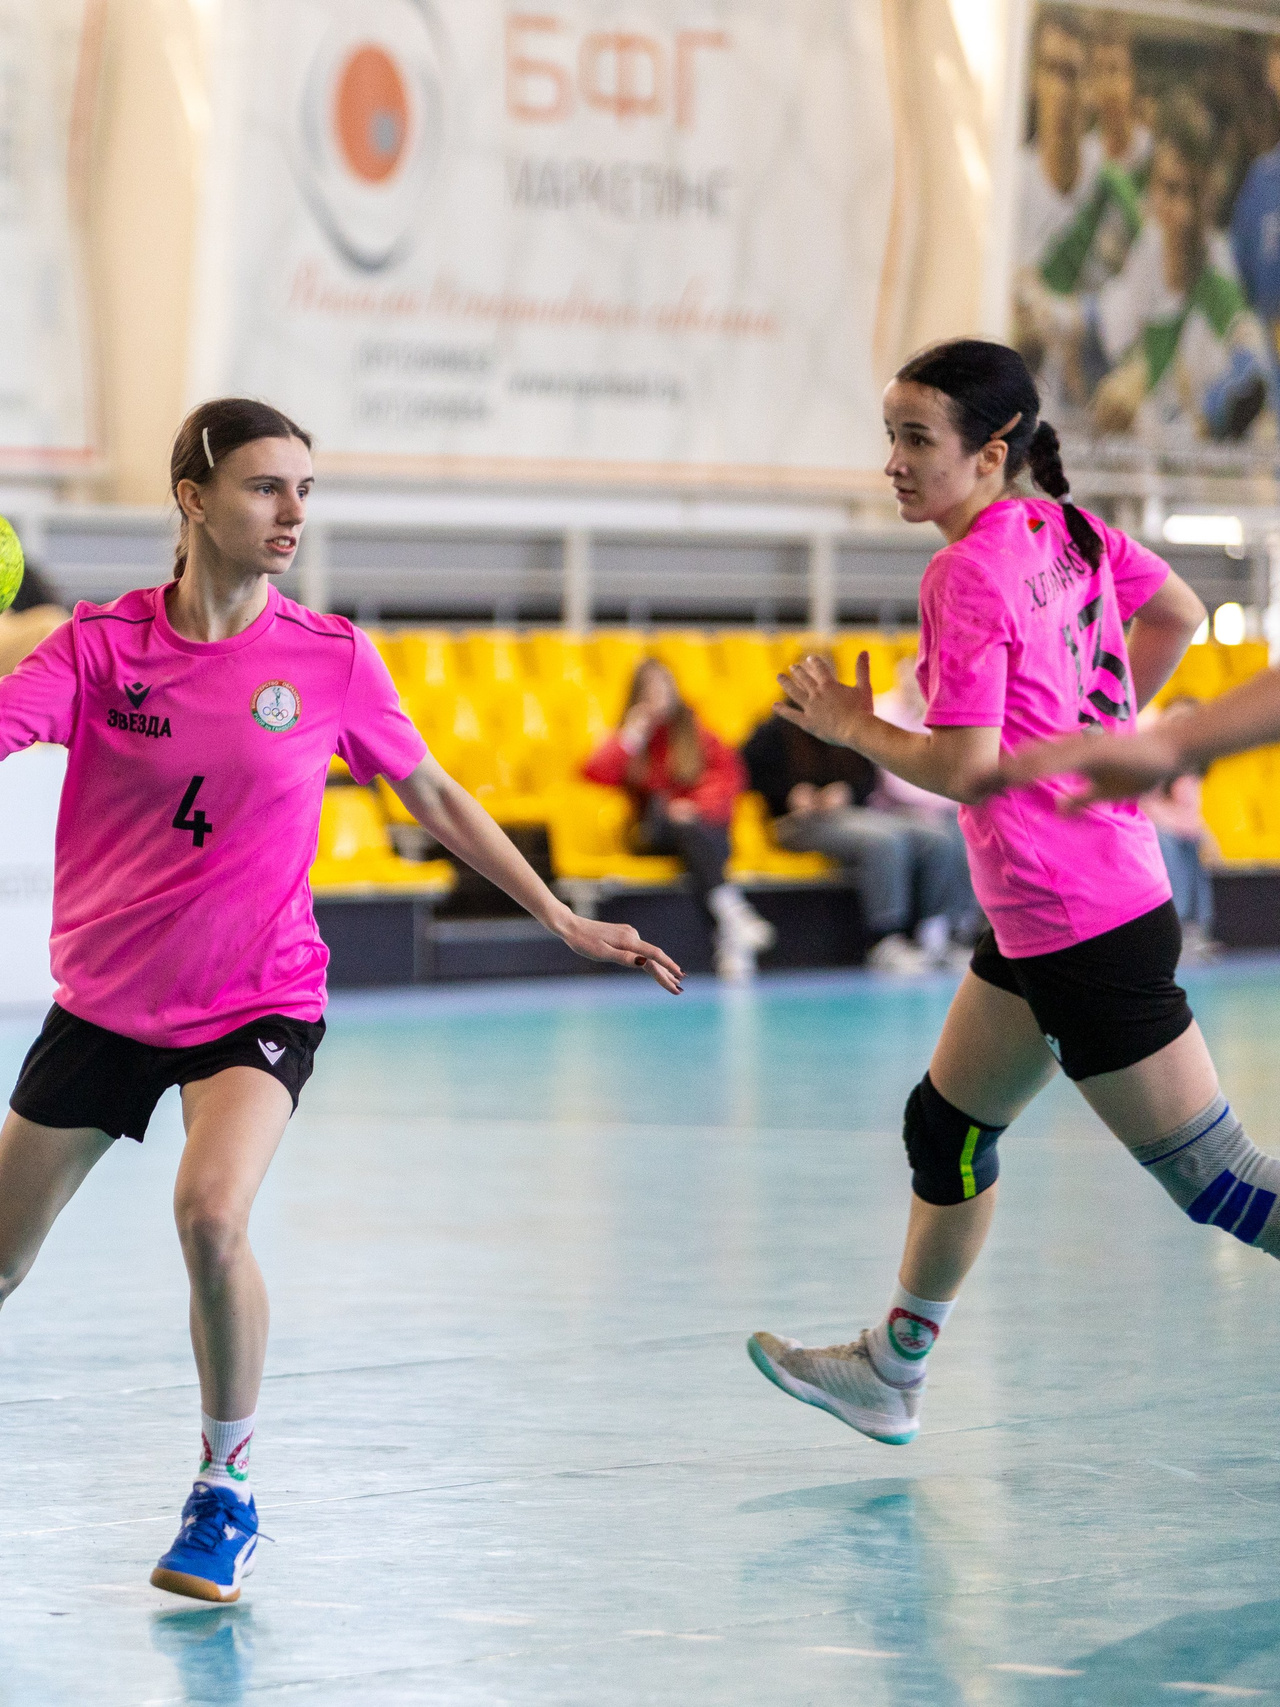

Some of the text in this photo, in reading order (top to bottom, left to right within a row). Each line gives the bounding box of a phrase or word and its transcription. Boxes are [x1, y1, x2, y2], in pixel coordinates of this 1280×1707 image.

[504, 14, 728, 128] БФГ
[107, 708, 172, 738] ЗВЕЗДА
[172, 775, 213, 848] 4
